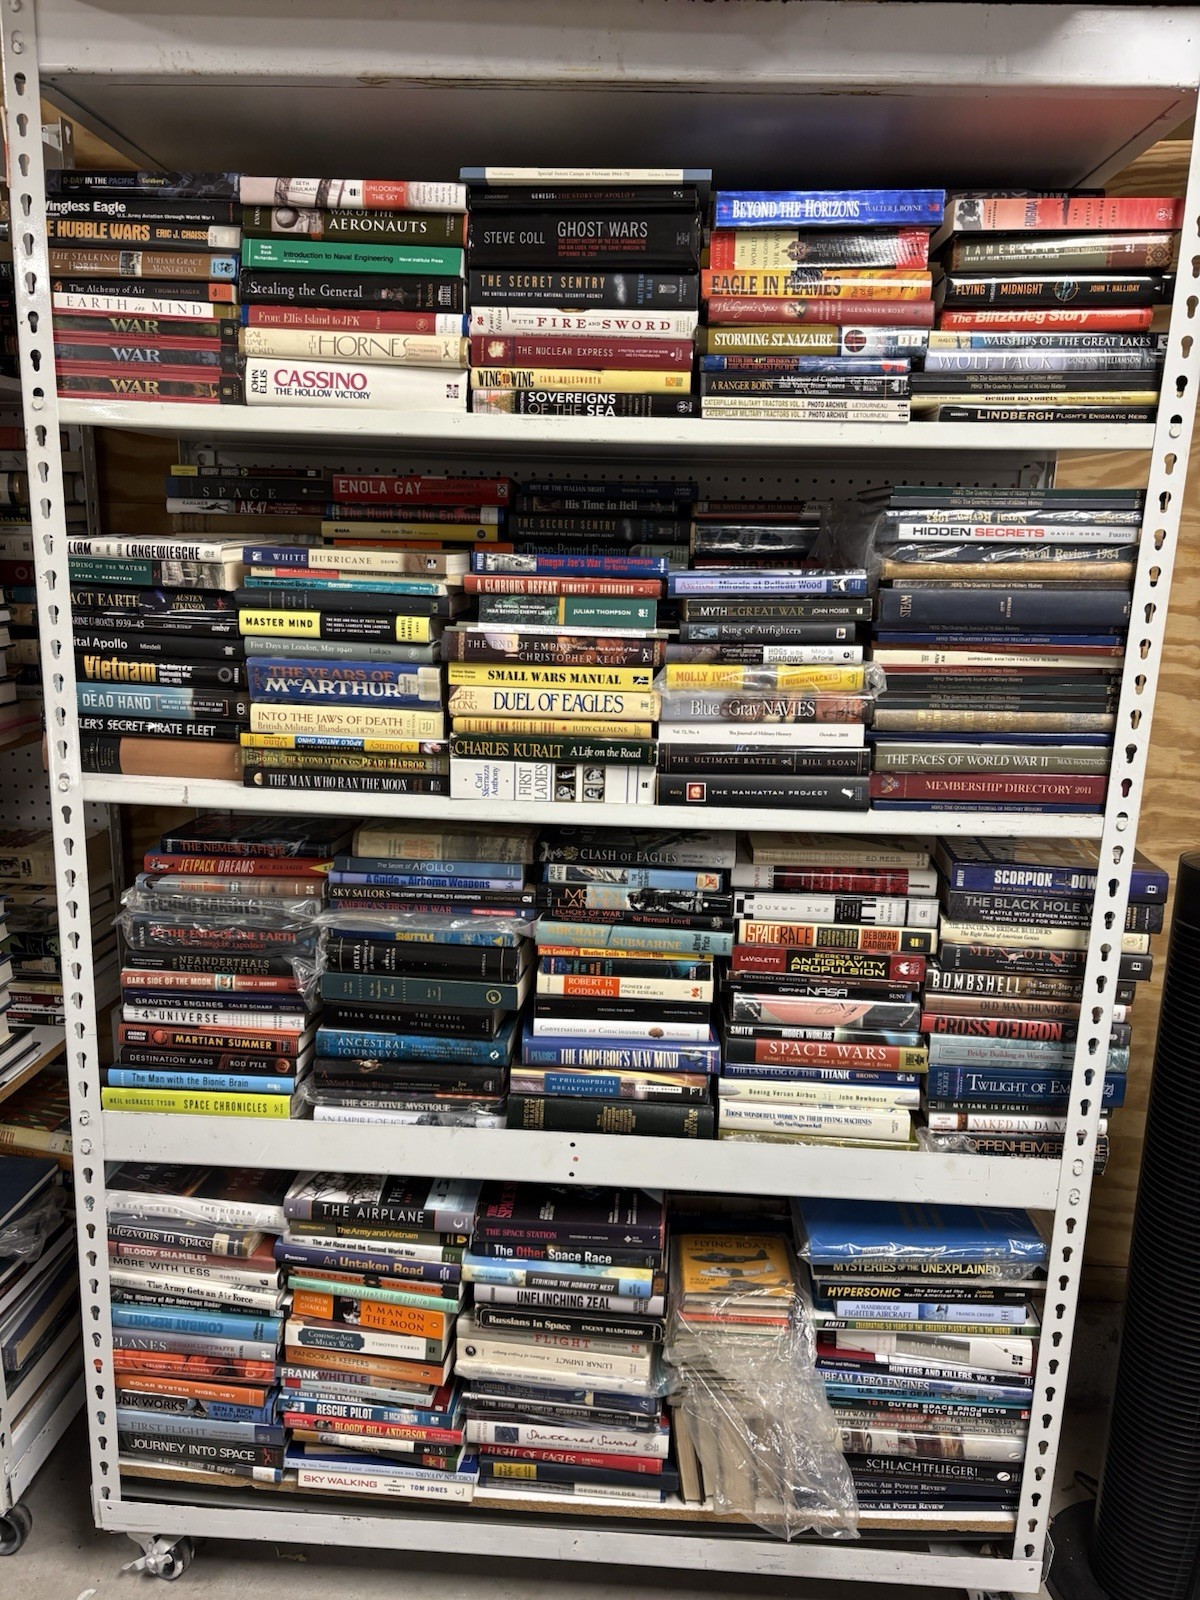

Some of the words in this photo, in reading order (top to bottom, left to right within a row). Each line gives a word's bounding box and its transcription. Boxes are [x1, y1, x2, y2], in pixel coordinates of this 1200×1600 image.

[93, 202, 126, 215] Eagle
[732, 200, 777, 218] BEYOND
[779, 200, 801, 218] THE
[805, 200, 860, 217] HORIZONS
[57, 222, 107, 239] HUBBLE
[110, 223, 150, 240] WARS
[329, 219, 427, 233] AERONAUTS
[558, 222, 603, 237] GHOST
[608, 223, 648, 237] WARS
[484, 232, 515, 244] STEVE
[520, 232, 545, 244] COLL
[284, 251, 323, 259] Introduction
[354, 254, 393, 263] Engineering
[481, 275, 501, 286] THE
[509, 275, 552, 288] SECRET
[561, 277, 605, 289] SENTRY
[956, 283, 985, 295] FLYING
[1001, 283, 1043, 294] MIDNIGHT
[87, 285, 121, 295] Alchemy
[123, 286, 131, 294] of
[250, 282, 294, 299] Stealing
[299, 284, 316, 296] the
[320, 285, 362, 297] General
[67, 296, 127, 310] EARTH
[134, 304, 145, 312] in
[152, 302, 202, 315] MIND
[110, 319, 158, 334] WAR
[537, 317, 586, 328] FIRE
[602, 320, 670, 330] SWORD
[983, 336, 1036, 346] WARSHIPS
[1040, 337, 1055, 345] OF
[1058, 337, 1079, 345] THE
[1082, 337, 1116, 345] GREAT
[1119, 338, 1150, 346] LAKES
[111, 348, 160, 362] WAR
[110, 379, 159, 394] WAR
[274, 369, 367, 390] CASSINO
[275, 388, 292, 396] THE
[295, 389, 333, 397] HOLLOW
[336, 391, 371, 400] VICTORY
[528, 392, 616, 404] SOVEREIGNS
[977, 409, 1054, 420] LINDBERGH
[203, 487, 276, 499] SPACE
[339, 480, 388, 495] ENOLA
[394, 481, 422, 496] GAY
[913, 527, 971, 537] HIDDEN
[975, 528, 1045, 538] SECRETS
[273, 553, 306, 561] WHITE
[312, 556, 372, 564] HURRICANE
[246, 618, 283, 627] MASTER
[289, 618, 313, 628] MIND
[722, 626, 740, 635] King
[758, 626, 801, 636] Airfighters
[93, 638, 127, 649] Apollo
[84, 655, 156, 682] Vietnam
[488, 671, 528, 681] SMALL
[532, 672, 566, 682] WARS
[570, 674, 621, 684] MANUAL
[83, 693, 113, 708] DEAD
[119, 696, 151, 709] HAND
[494, 692, 535, 710] DUEL
[538, 694, 559, 711] OF
[562, 695, 624, 713] EAGLES
[691, 701, 719, 716] Blue
[729, 701, 760, 717] Gray
[763, 701, 815, 716] NAVIES
[258, 712, 287, 721] INTO
[290, 713, 313, 721] THE
[317, 714, 343, 723] JAWS
[346, 715, 362, 724] OF
[366, 716, 403, 726] DEATH
[455, 741, 509, 757] CHARLES
[513, 743, 563, 758] KURALT
[578, 747, 593, 757] Life
[607, 748, 619, 757] the
[620, 748, 641, 758] Road
[912, 755, 945, 765] FACES
[949, 755, 963, 765] OF
[967, 756, 1009, 766] WORLD
[1013, 756, 1037, 766] WAR
[269, 774, 288, 786] THE
[290, 776, 311, 786] MAN
[314, 777, 336, 787] WHO
[338, 778, 357, 788] RAN
[360, 778, 379, 789] THE
[381, 779, 407, 790] MOON
[519, 767, 532, 796] FIRST
[535, 765, 548, 800] LADIES
[926, 781, 1002, 792] MEMBERSHIP
[1006, 782, 1072, 794] DIRECTORY
[1075, 786, 1092, 794] 2011
[580, 849, 616, 861] CLASH
[621, 852, 632, 861] OF
[637, 851, 677, 863] EAGLES
[178, 859, 215, 872] JETPACK
[218, 860, 255, 873] DREAMS
[412, 862, 454, 872] APOLLO
[995, 871, 1052, 887] SCORPION
[791, 957, 885, 968] ANTIGRAVITY
[791, 965, 885, 976] PROPULSION
[568, 978, 601, 986] ROBERT
[932, 972, 1021, 993] BOMBSHELL
[568, 987, 613, 996] GODDARD
[807, 987, 848, 997] NASA
[159, 1011, 218, 1024] UNIVERSE
[175, 1034, 225, 1047] MARTIAN
[228, 1038, 271, 1049] SUMMER
[769, 1042, 827, 1056] SPACE
[837, 1046, 886, 1059] WARS
[184, 1100, 210, 1110] SPACE
[213, 1101, 267, 1113] CHRONICLES
[322, 1204, 349, 1217] THE
[358, 1208, 425, 1223] AIRPLANE
[123, 1248, 157, 1256] BLOODY
[160, 1251, 207, 1261] SHAMBLES
[494, 1245, 513, 1256] The
[516, 1247, 545, 1258] Other
[548, 1249, 582, 1261] Space
[585, 1252, 612, 1263] Race
[114, 1258, 146, 1268] MORE
[150, 1262, 178, 1273] WITH
[183, 1267, 210, 1277] LESS
[339, 1257, 390, 1272] Untaken
[394, 1264, 424, 1275] Road
[833, 1262, 896, 1273] MYSTERIES
[827, 1286, 900, 1297] HYPERSONIC
[517, 1291, 583, 1308] UNFLINCHING
[587, 1297, 611, 1309] ZEAL
[377, 1307, 402, 1317] MAN
[408, 1311, 425, 1321] ON
[366, 1315, 386, 1324] THE
[388, 1317, 425, 1332] MOON
[316, 1404, 349, 1417] RESCUE
[351, 1407, 373, 1419] PILOT
[131, 1439, 186, 1453] JOURNEY
[189, 1444, 216, 1455] INTO
[220, 1448, 256, 1460] SPACE
[867, 1459, 978, 1476] SCHLACHTFLIEGER!
[304, 1475, 324, 1484] SKY
[327, 1477, 377, 1488] WALKING
